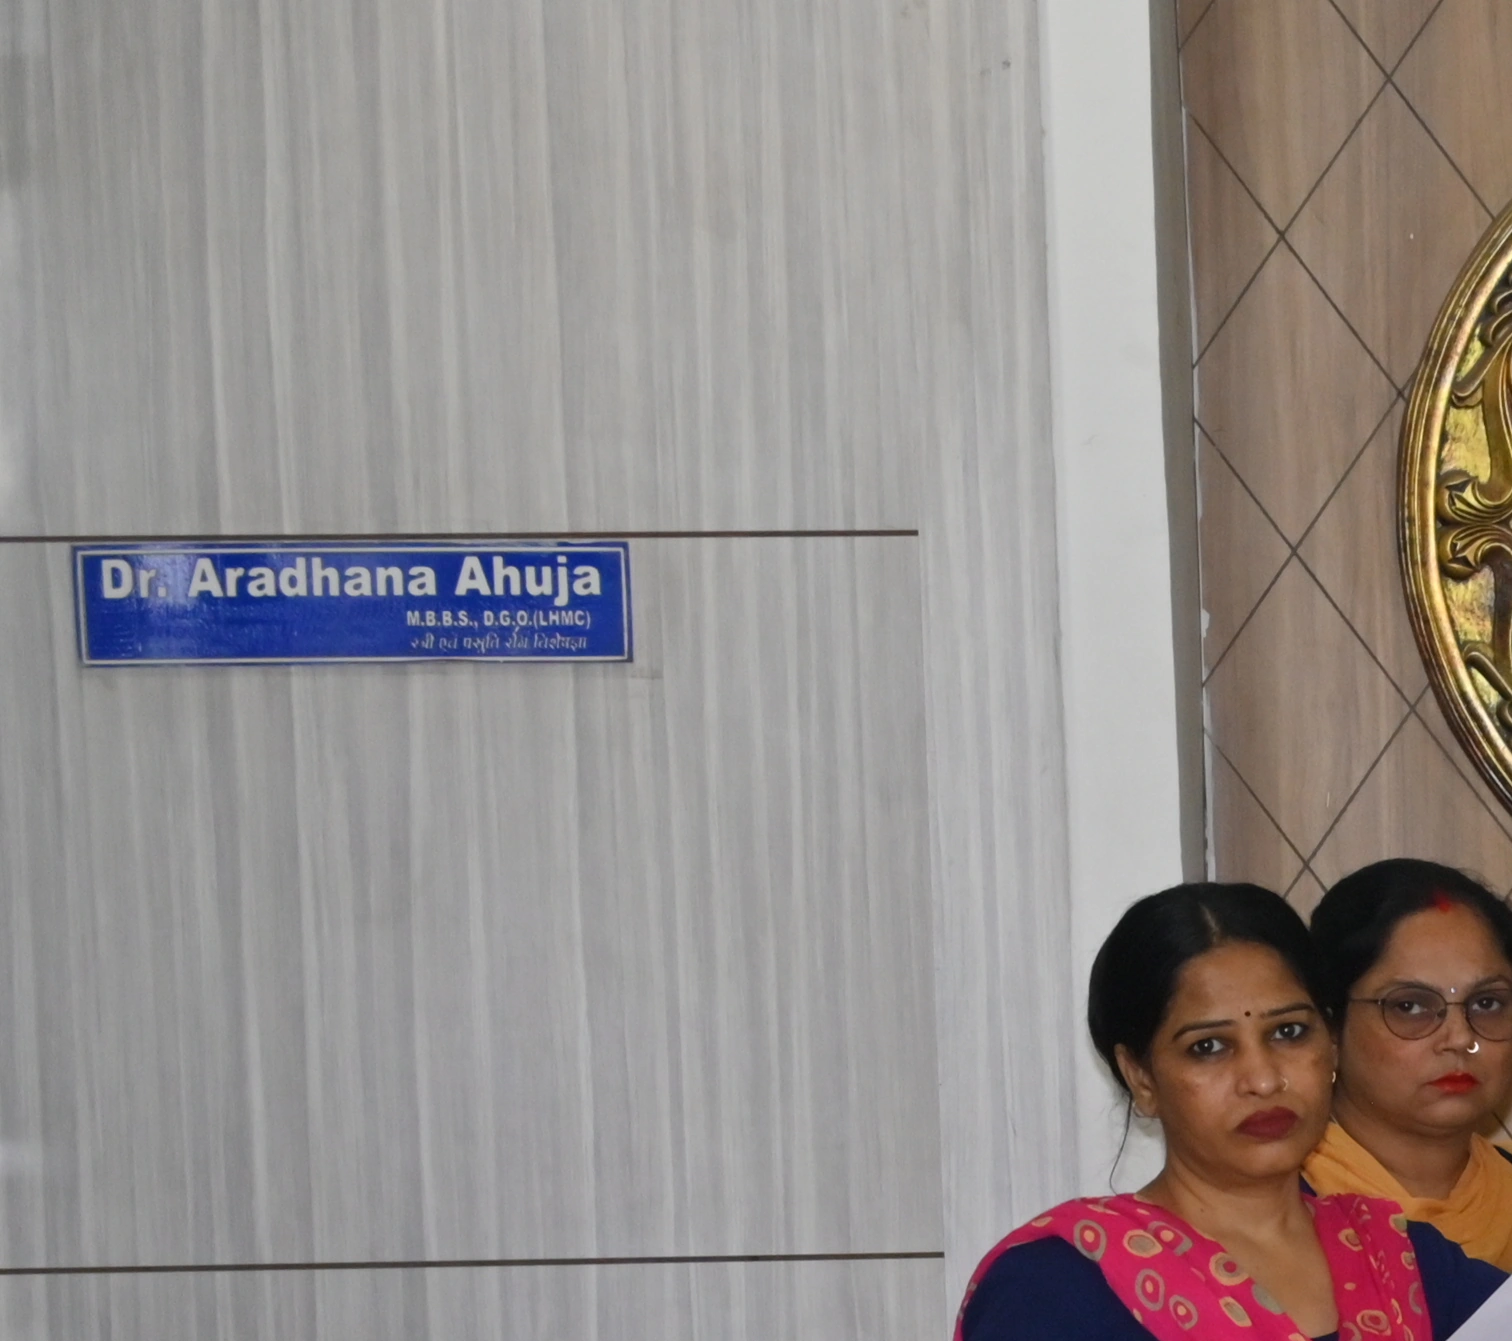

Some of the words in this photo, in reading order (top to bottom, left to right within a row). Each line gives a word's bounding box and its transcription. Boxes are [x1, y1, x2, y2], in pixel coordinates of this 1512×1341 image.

[100, 558, 167, 600] Dr.
[187, 557, 437, 598] Aradhana
[454, 556, 601, 606] Ahuja
[407, 610, 479, 628] M.B.B.S.,
[483, 610, 591, 629] D.G.O.(LHMC)
